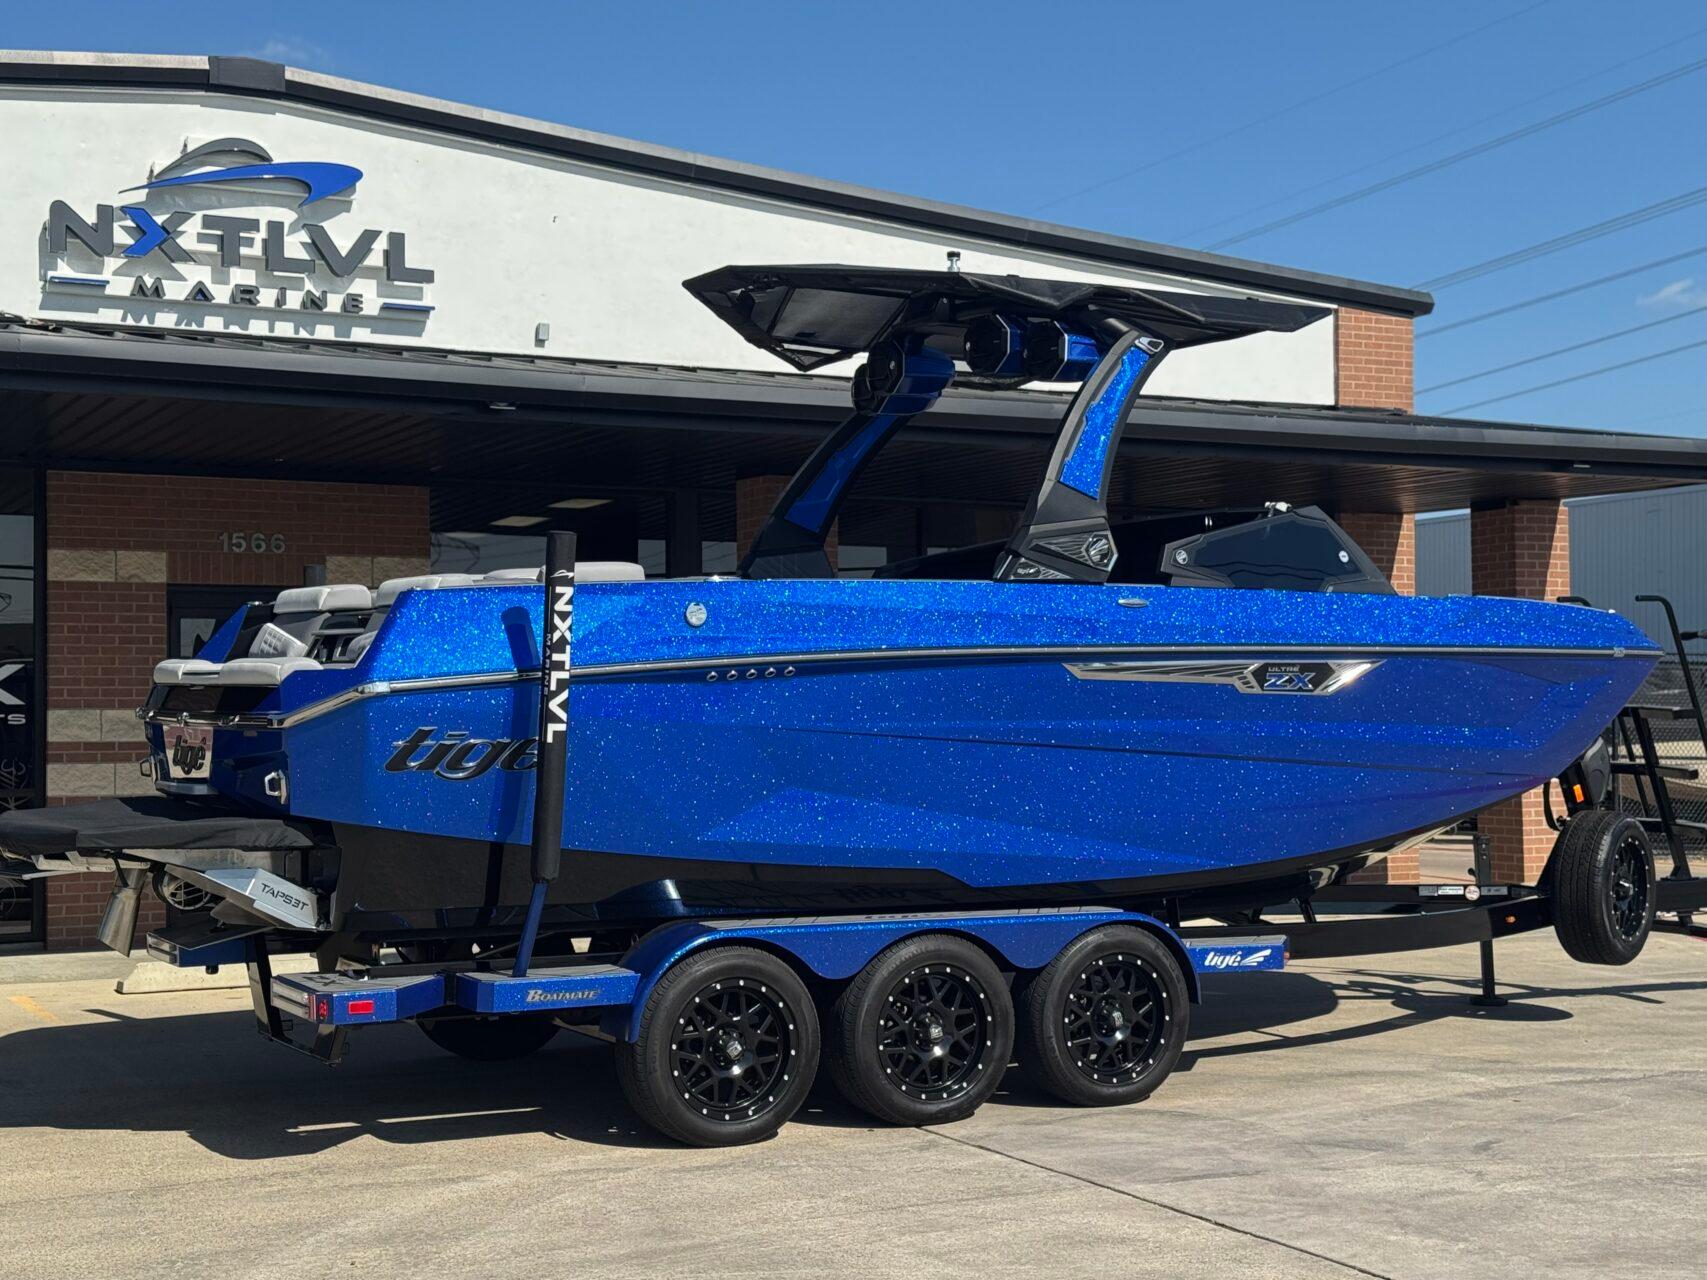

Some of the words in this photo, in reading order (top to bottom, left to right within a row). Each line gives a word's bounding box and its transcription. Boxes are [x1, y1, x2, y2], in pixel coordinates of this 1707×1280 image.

[48, 199, 435, 284] NXTLVL
[131, 275, 364, 314] MARINE
[219, 532, 286, 553] 1566
[546, 585, 575, 744] NXTLVL
[1263, 672, 1316, 690] ZX
